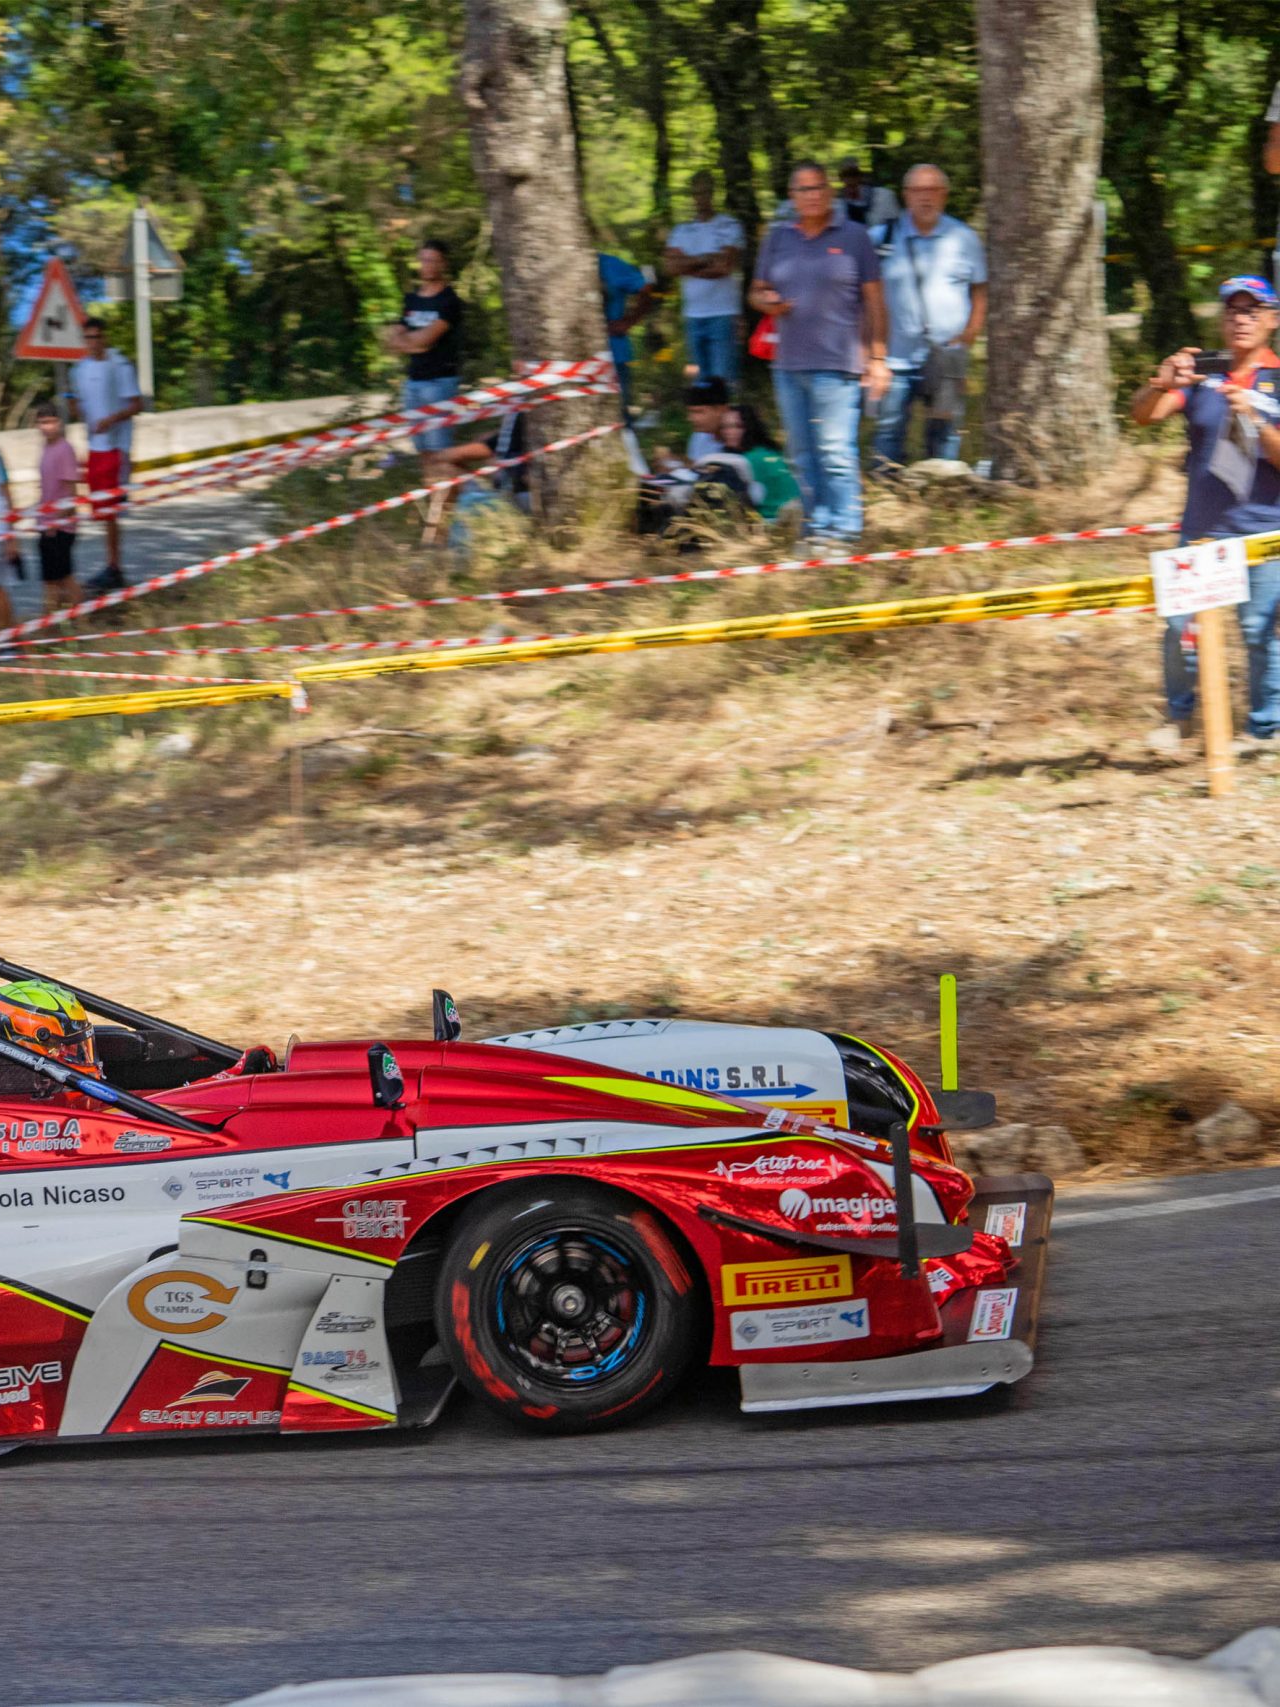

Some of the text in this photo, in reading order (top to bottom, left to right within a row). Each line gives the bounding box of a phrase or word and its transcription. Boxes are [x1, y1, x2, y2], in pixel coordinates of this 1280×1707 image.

[2, 1142, 9, 1152] E
[18, 1138, 81, 1152] LOGISTICA
[195, 1177, 254, 1190] SPORT
[740, 1176, 830, 1186] GRAPHIC PROJECT
[43, 1185, 125, 1206] Nicaso
[812, 1193, 897, 1220] magiga
[343, 1220, 406, 1239] DESIGN
[734, 1264, 840, 1297] PIRELLI
[165, 1291, 194, 1303] TGS
[154, 1305, 190, 1314] STAMPI
[771, 1316, 833, 1332] SPORT
[139, 1410, 283, 1425] SEACILY SUPPLIES
